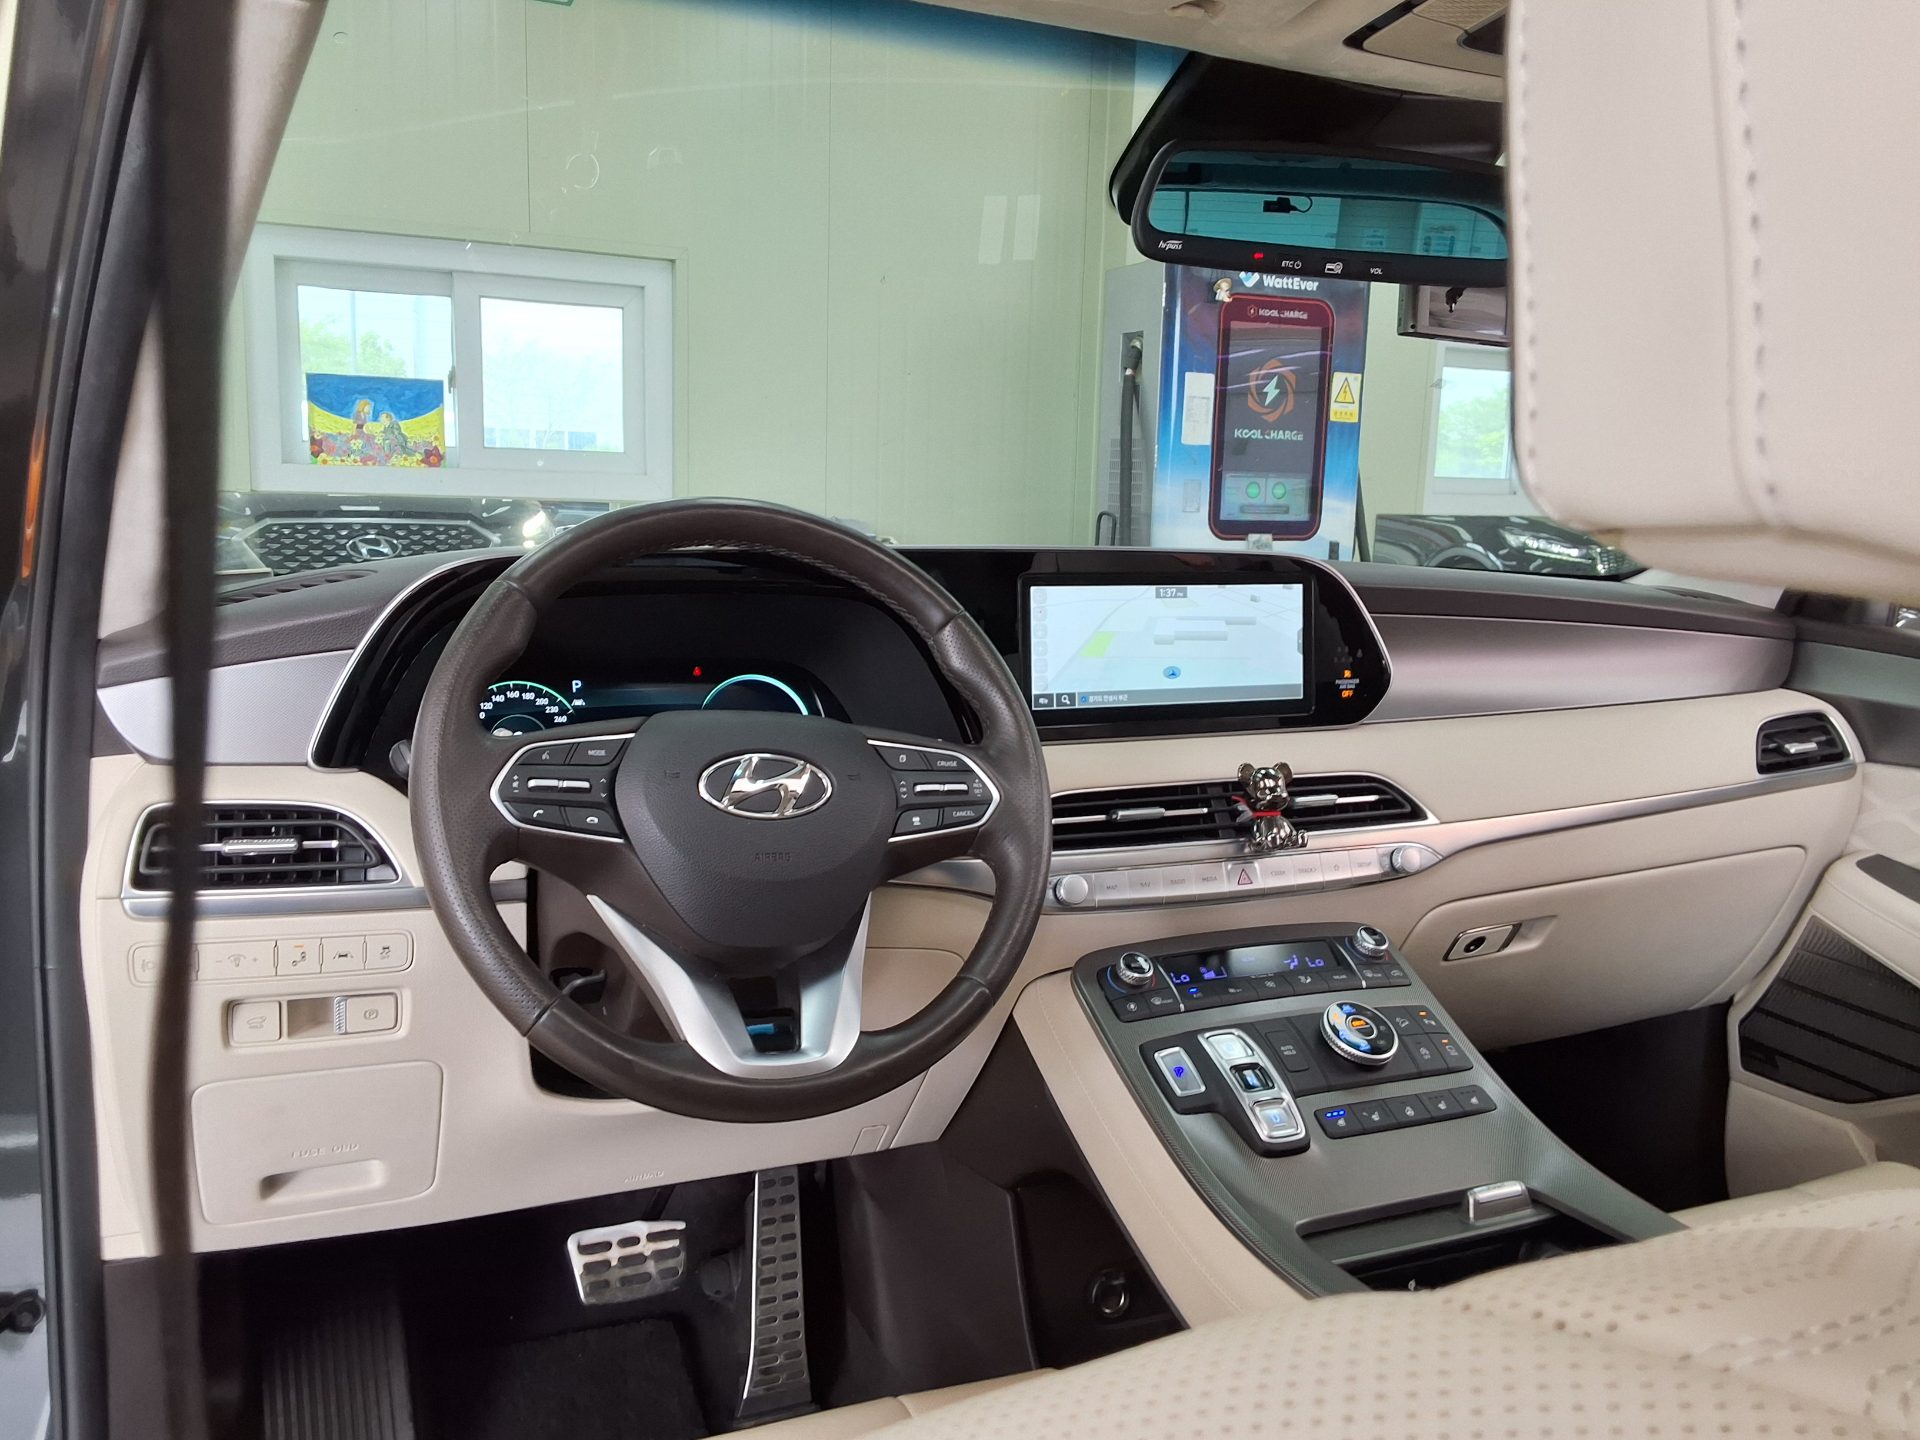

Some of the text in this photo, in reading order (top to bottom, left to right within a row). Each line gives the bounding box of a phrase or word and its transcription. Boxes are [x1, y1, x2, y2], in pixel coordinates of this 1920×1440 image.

[1281, 260, 1293, 268] ETC
[1370, 267, 1383, 275] VOL
[1262, 274, 1319, 292] WattEver
[1234, 428, 1304, 440] KOOL CHARGE
[1160, 588, 1176, 597] 1:37
[572, 680, 582, 693] P
[1341, 690, 1354, 698] OFF
[535, 698, 549, 706] 200
